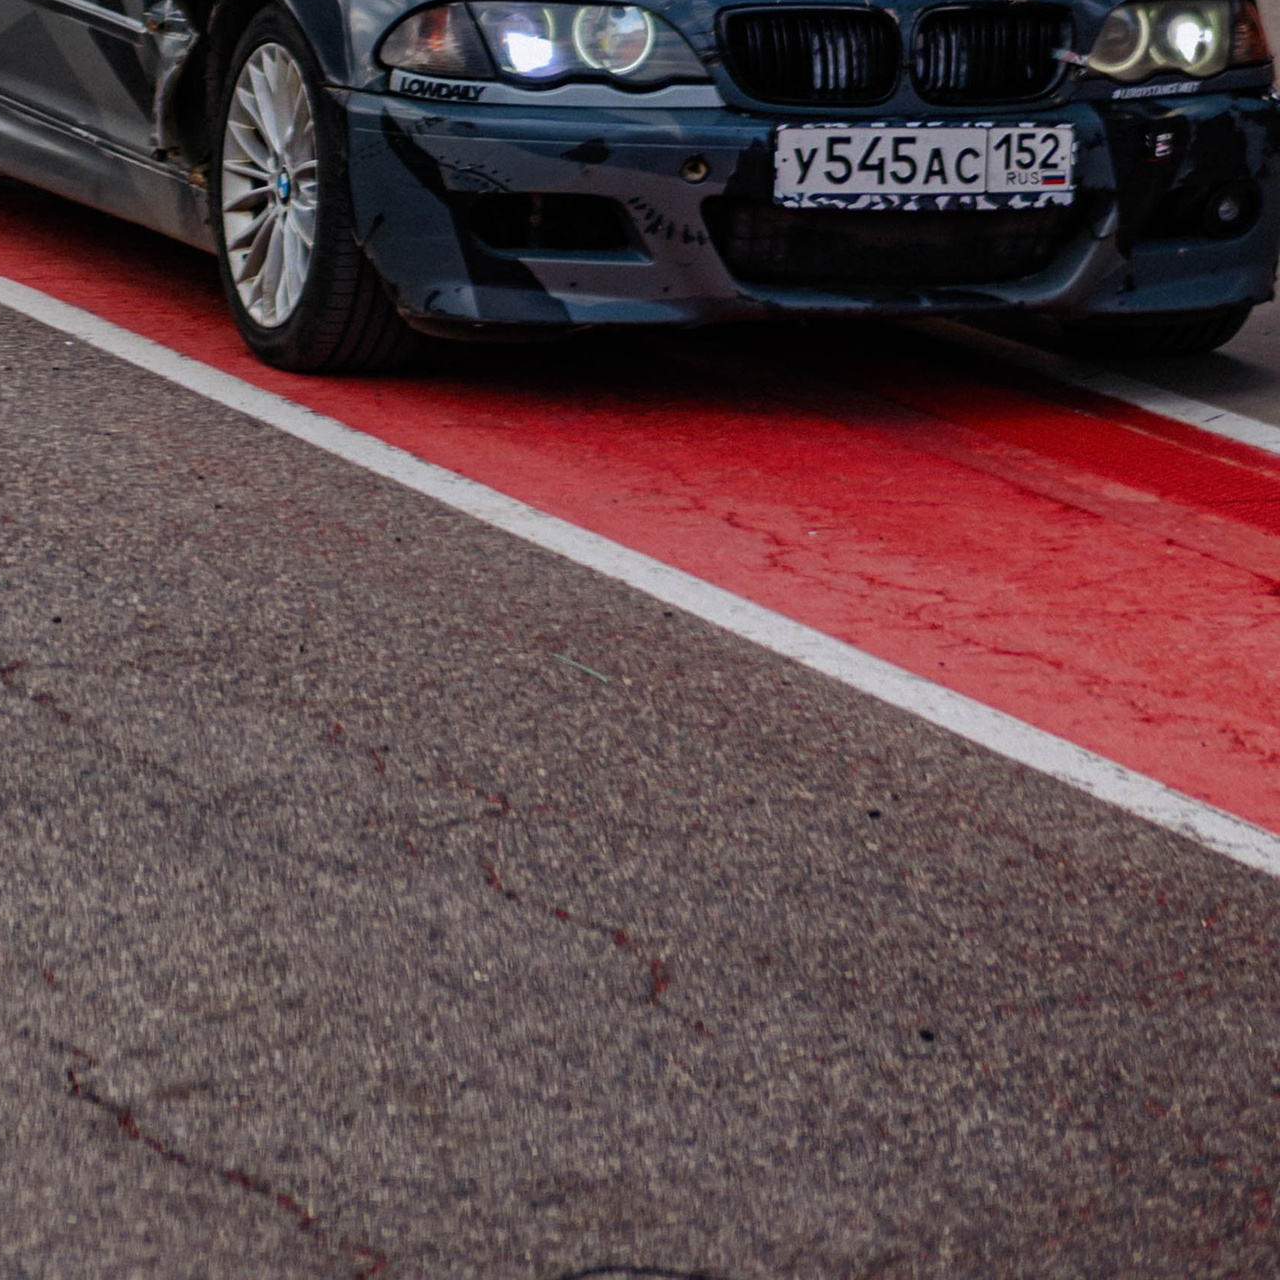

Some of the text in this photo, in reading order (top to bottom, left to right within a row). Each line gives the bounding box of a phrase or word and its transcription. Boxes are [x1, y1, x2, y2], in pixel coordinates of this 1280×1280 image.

[400, 76, 488, 101] LOWDAILY
[794, 133, 1061, 185] У545АС 152
[1006, 171, 1041, 185] RUS
